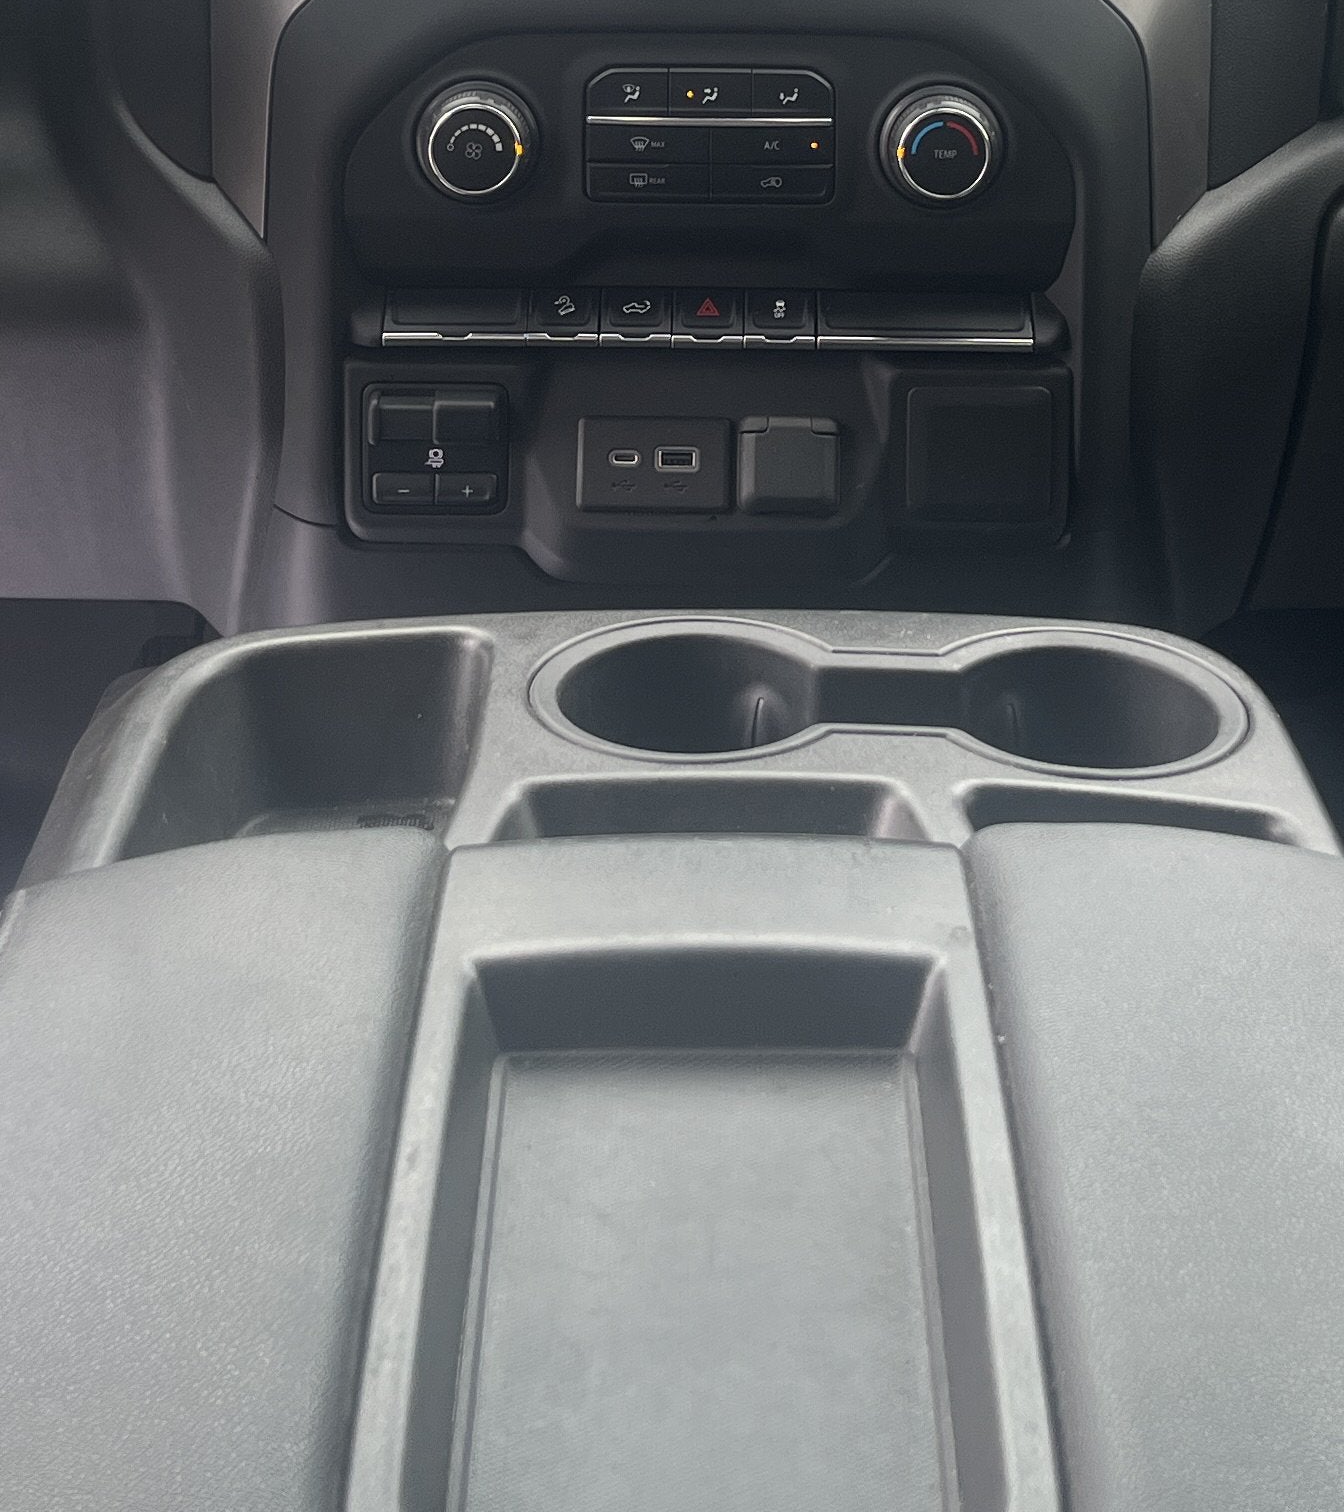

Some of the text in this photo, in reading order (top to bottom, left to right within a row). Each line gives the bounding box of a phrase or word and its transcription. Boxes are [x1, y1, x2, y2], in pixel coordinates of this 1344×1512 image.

[764, 141, 780, 150] A/C
[934, 149, 957, 159] TEMP
[649, 177, 666, 185] REAR
